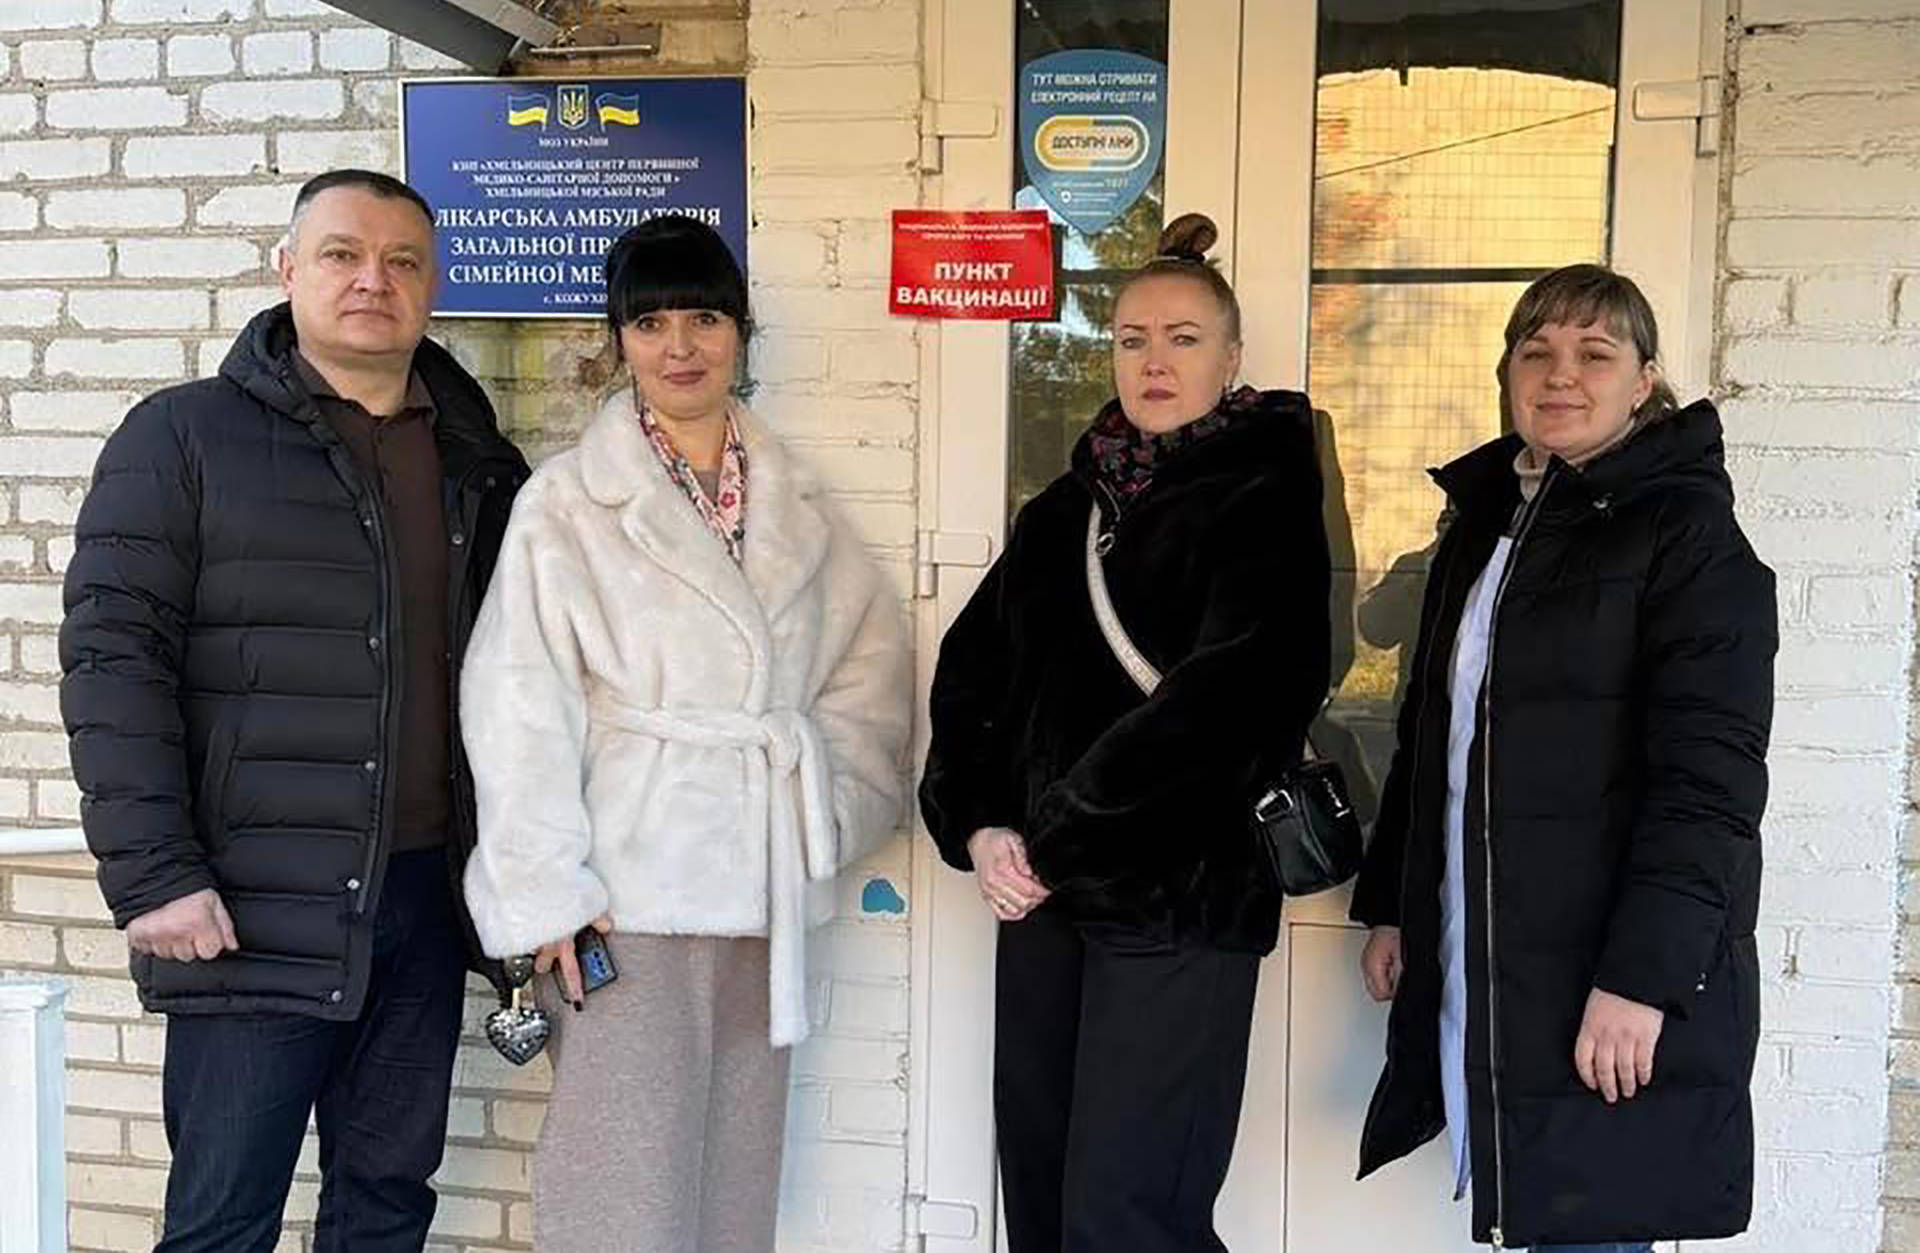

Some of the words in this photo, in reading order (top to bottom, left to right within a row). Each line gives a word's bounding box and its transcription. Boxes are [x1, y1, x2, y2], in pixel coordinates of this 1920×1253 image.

[1032, 73, 1053, 85] ТУТ
[1055, 73, 1097, 86] МОЖНА
[1098, 72, 1157, 87] ОТРИМАТИ
[1031, 89, 1101, 104] ЕЛЕКТРОННИЙ
[1103, 91, 1141, 104] РЕЦЕПТ
[1142, 91, 1157, 103] НА
[563, 135, 609, 147] УКРАЇНИ
[1052, 135, 1105, 149] ДОСТУПНІ
[1107, 135, 1134, 149] ЛІКИ
[586, 160, 626, 171] ЦЕНТР
[628, 158, 700, 170] ПЕРВИННОЇ
[486, 186, 579, 198] ХМІЛЬНИЦЬКОЇ
[581, 186, 633, 198] МІСЬКОЇ
[635, 187, 666, 198] РАДИ
[434, 207, 558, 227] ЛІКАРСЬКА
[450, 233, 575, 256] ЗАГАЛЬНОЇ
[580, 236, 617, 256] ПР
[448, 261, 566, 284] СІМЕЙНОЇ
[570, 265, 608, 286] МЕ
[934, 262, 1013, 282] ПУНКТ
[895, 285, 1047, 310] ВАКЦИНАЦІЇ
